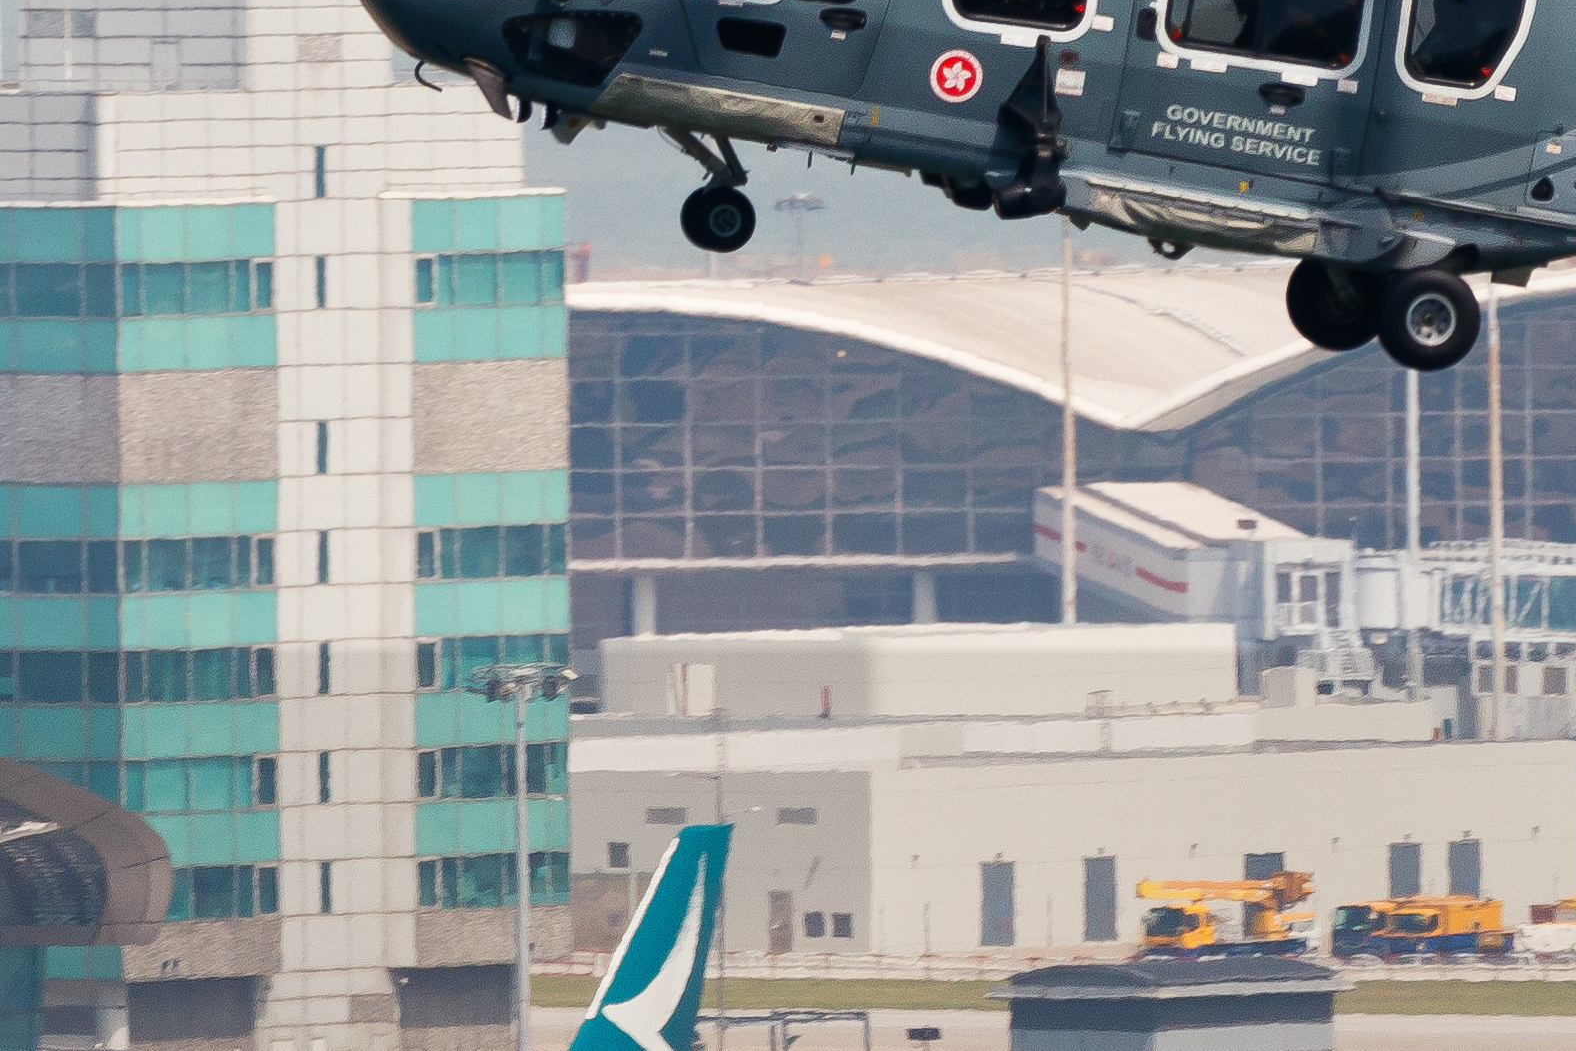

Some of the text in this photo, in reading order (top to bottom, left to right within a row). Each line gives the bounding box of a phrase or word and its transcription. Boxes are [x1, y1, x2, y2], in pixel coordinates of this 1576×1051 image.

[1151, 121, 1322, 166] FLYING SERVICE
[1166, 104, 1316, 144] GOVERNMENT
